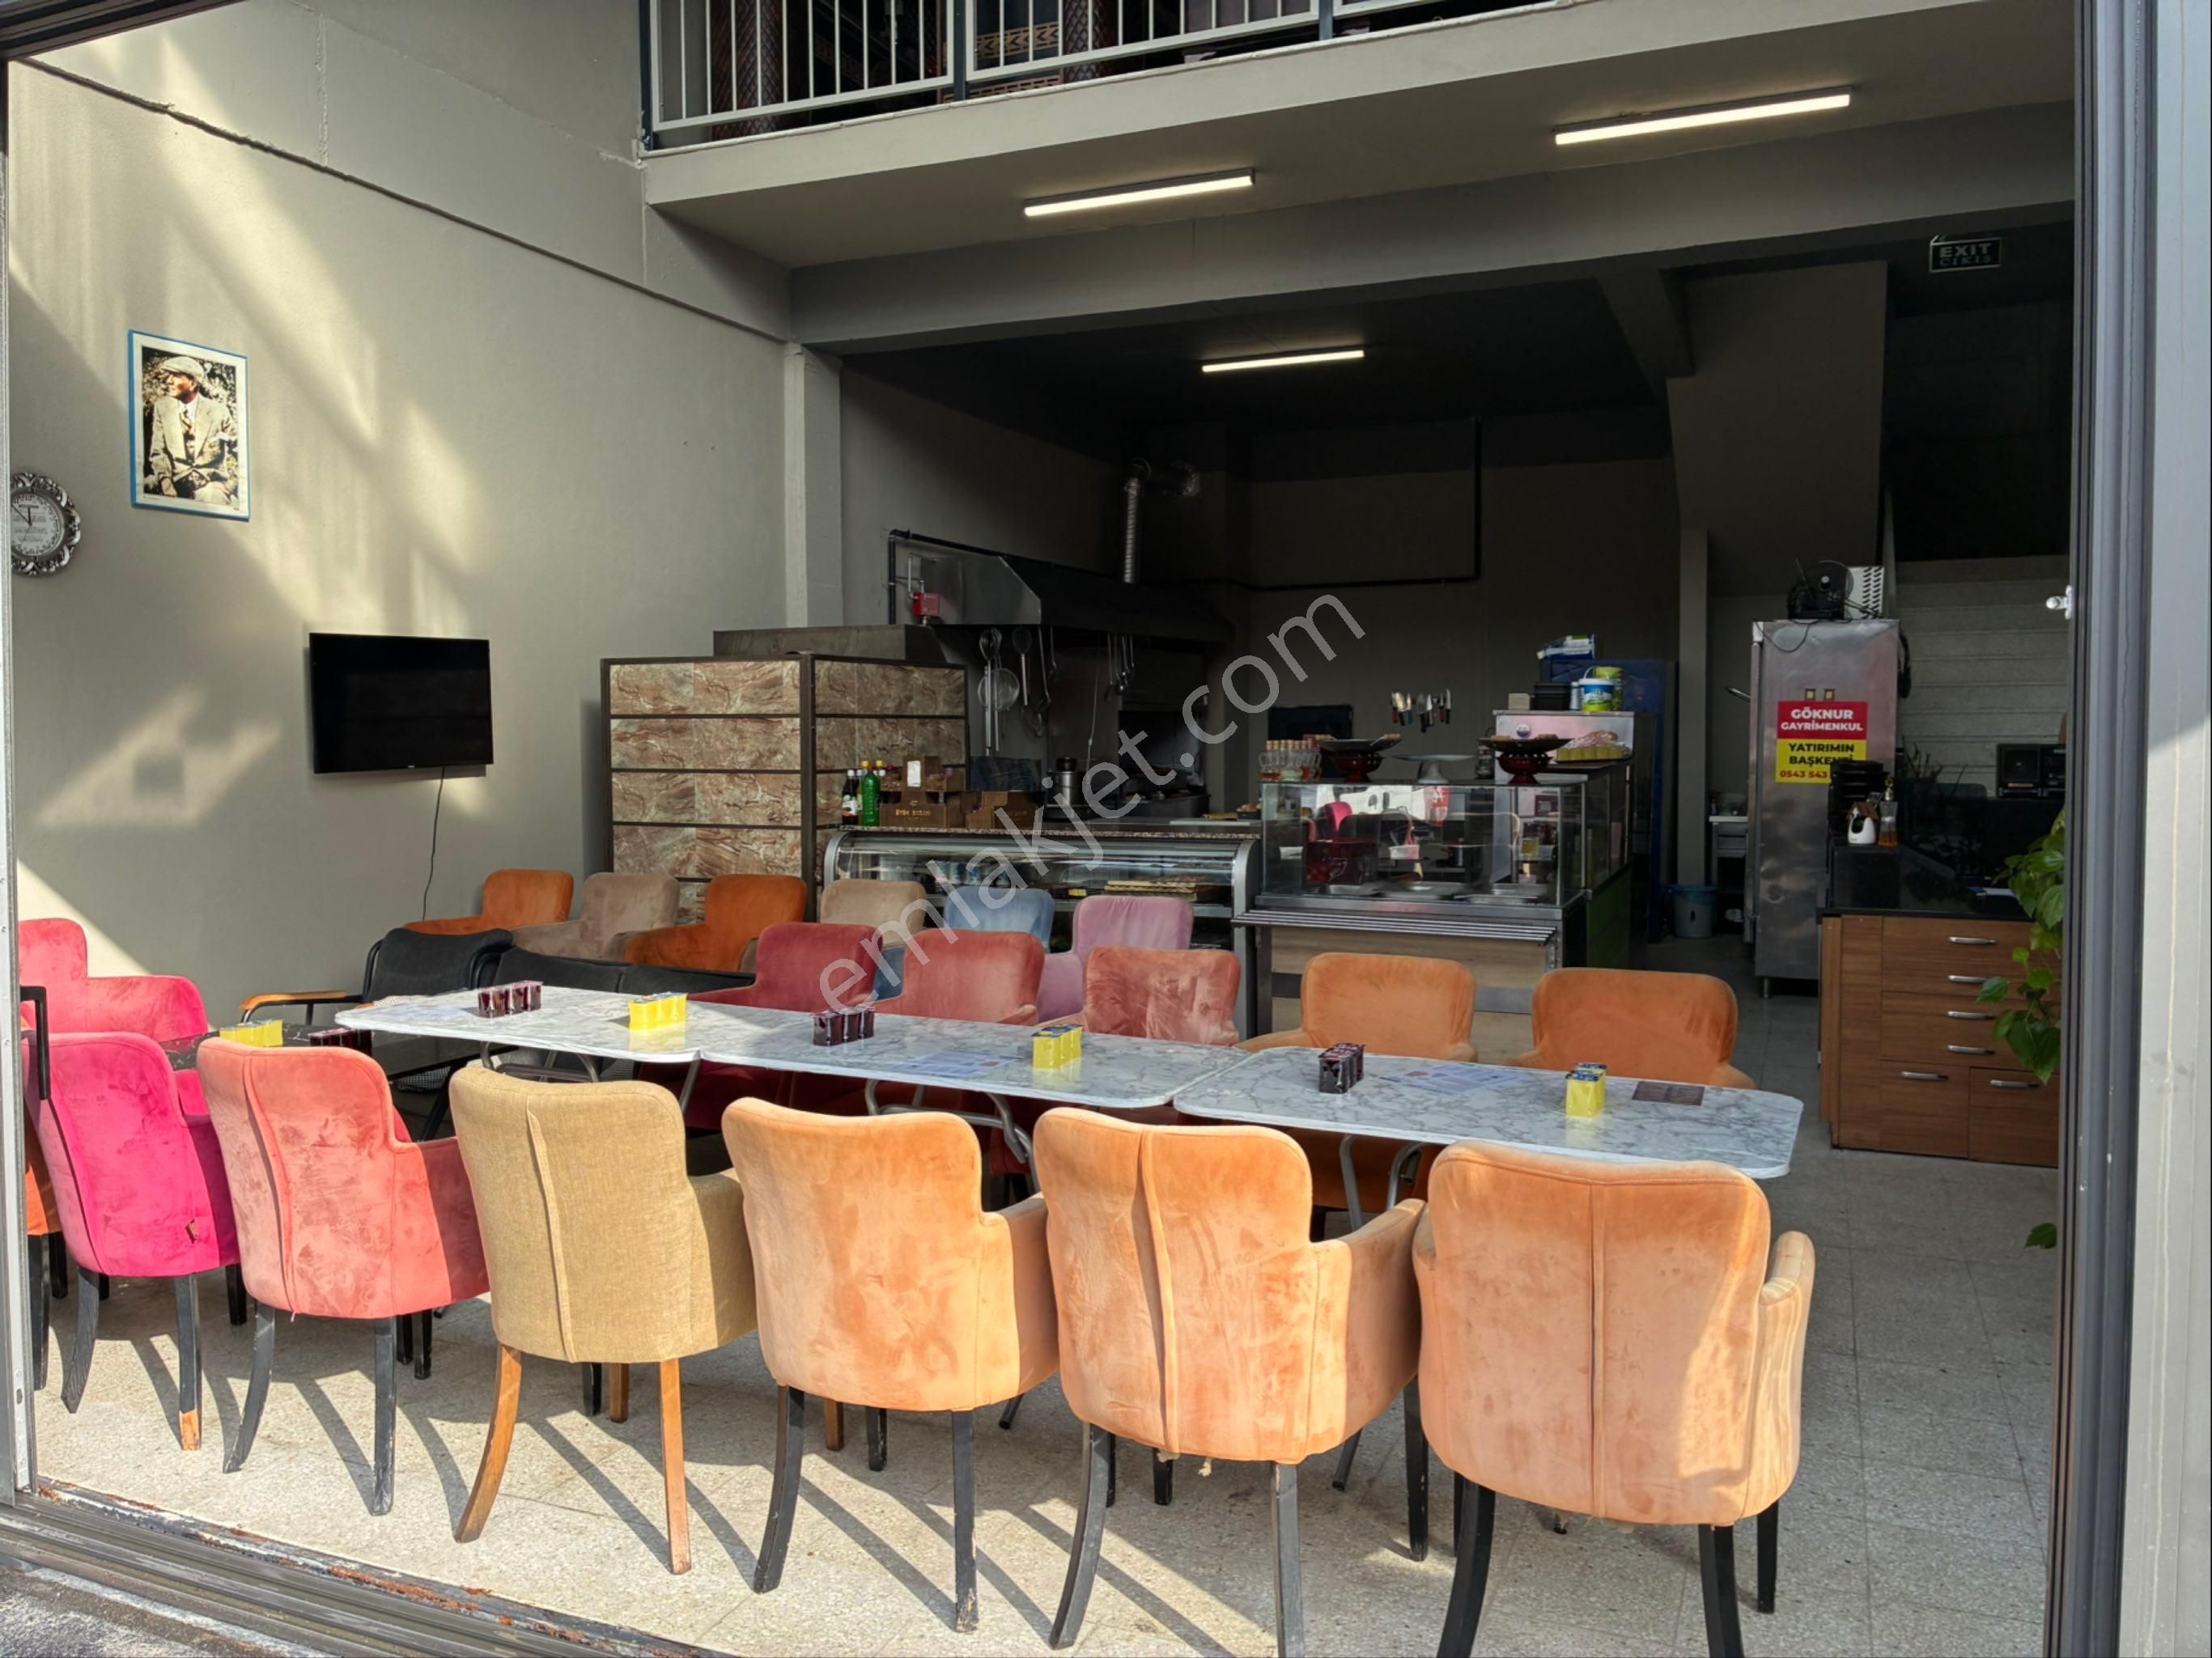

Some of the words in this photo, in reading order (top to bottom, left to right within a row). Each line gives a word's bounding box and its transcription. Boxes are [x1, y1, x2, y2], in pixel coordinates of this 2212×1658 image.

[1939, 243, 1992, 258] EXIT
[1791, 706, 1853, 719] GÖKNUR
[1781, 720, 1863, 731] GAYRİMENKUL
[1789, 744, 1854, 753] YATIRIMIN
[1808, 770, 1828, 778] 543
